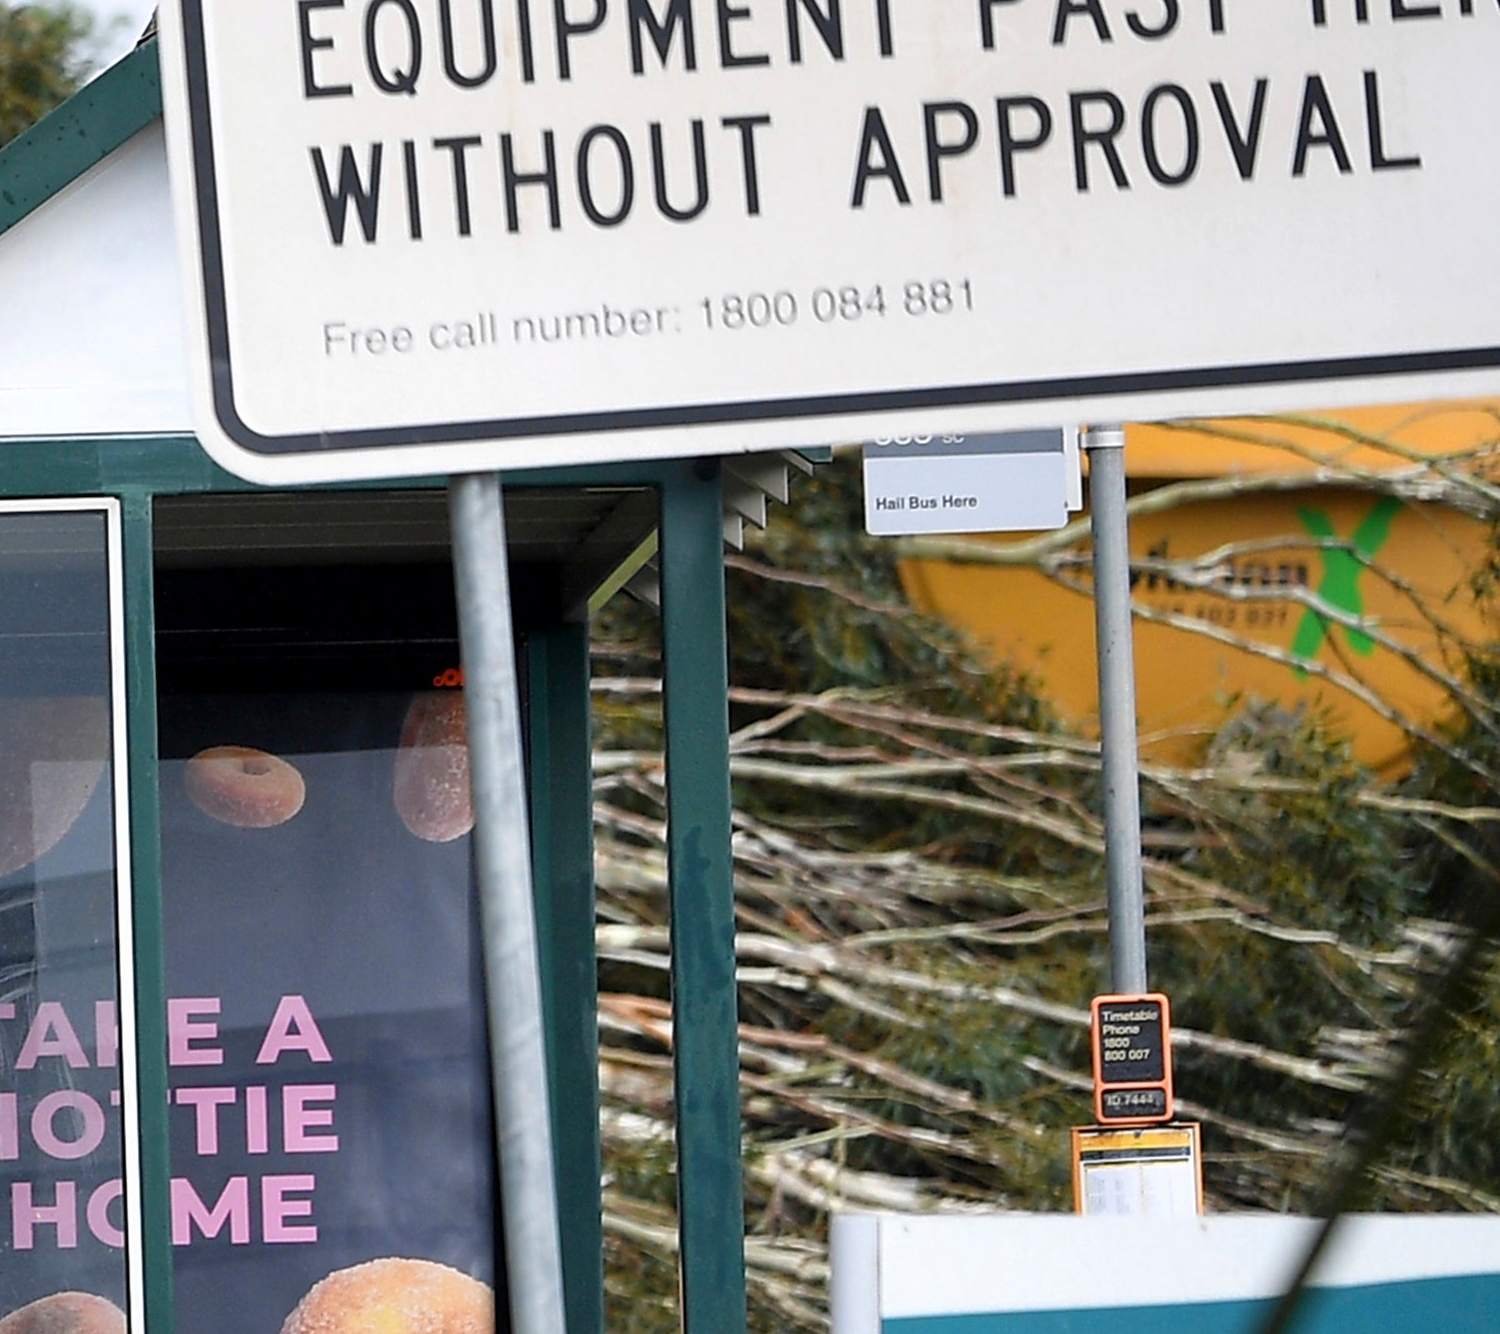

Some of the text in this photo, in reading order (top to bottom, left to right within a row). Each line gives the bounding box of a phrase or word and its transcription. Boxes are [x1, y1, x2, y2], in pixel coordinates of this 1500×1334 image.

[309, 69, 1422, 247] WITHOUT APPROVAL
[322, 279, 973, 355] Free call number: 1800 084 881
[876, 494, 978, 510] Hail Bus Here
[1102, 1010, 1159, 1022] Timetable
[255, 994, 333, 1064] A
[1102, 1024, 1140, 1035] Phone
[1103, 1037, 1130, 1048] 1800
